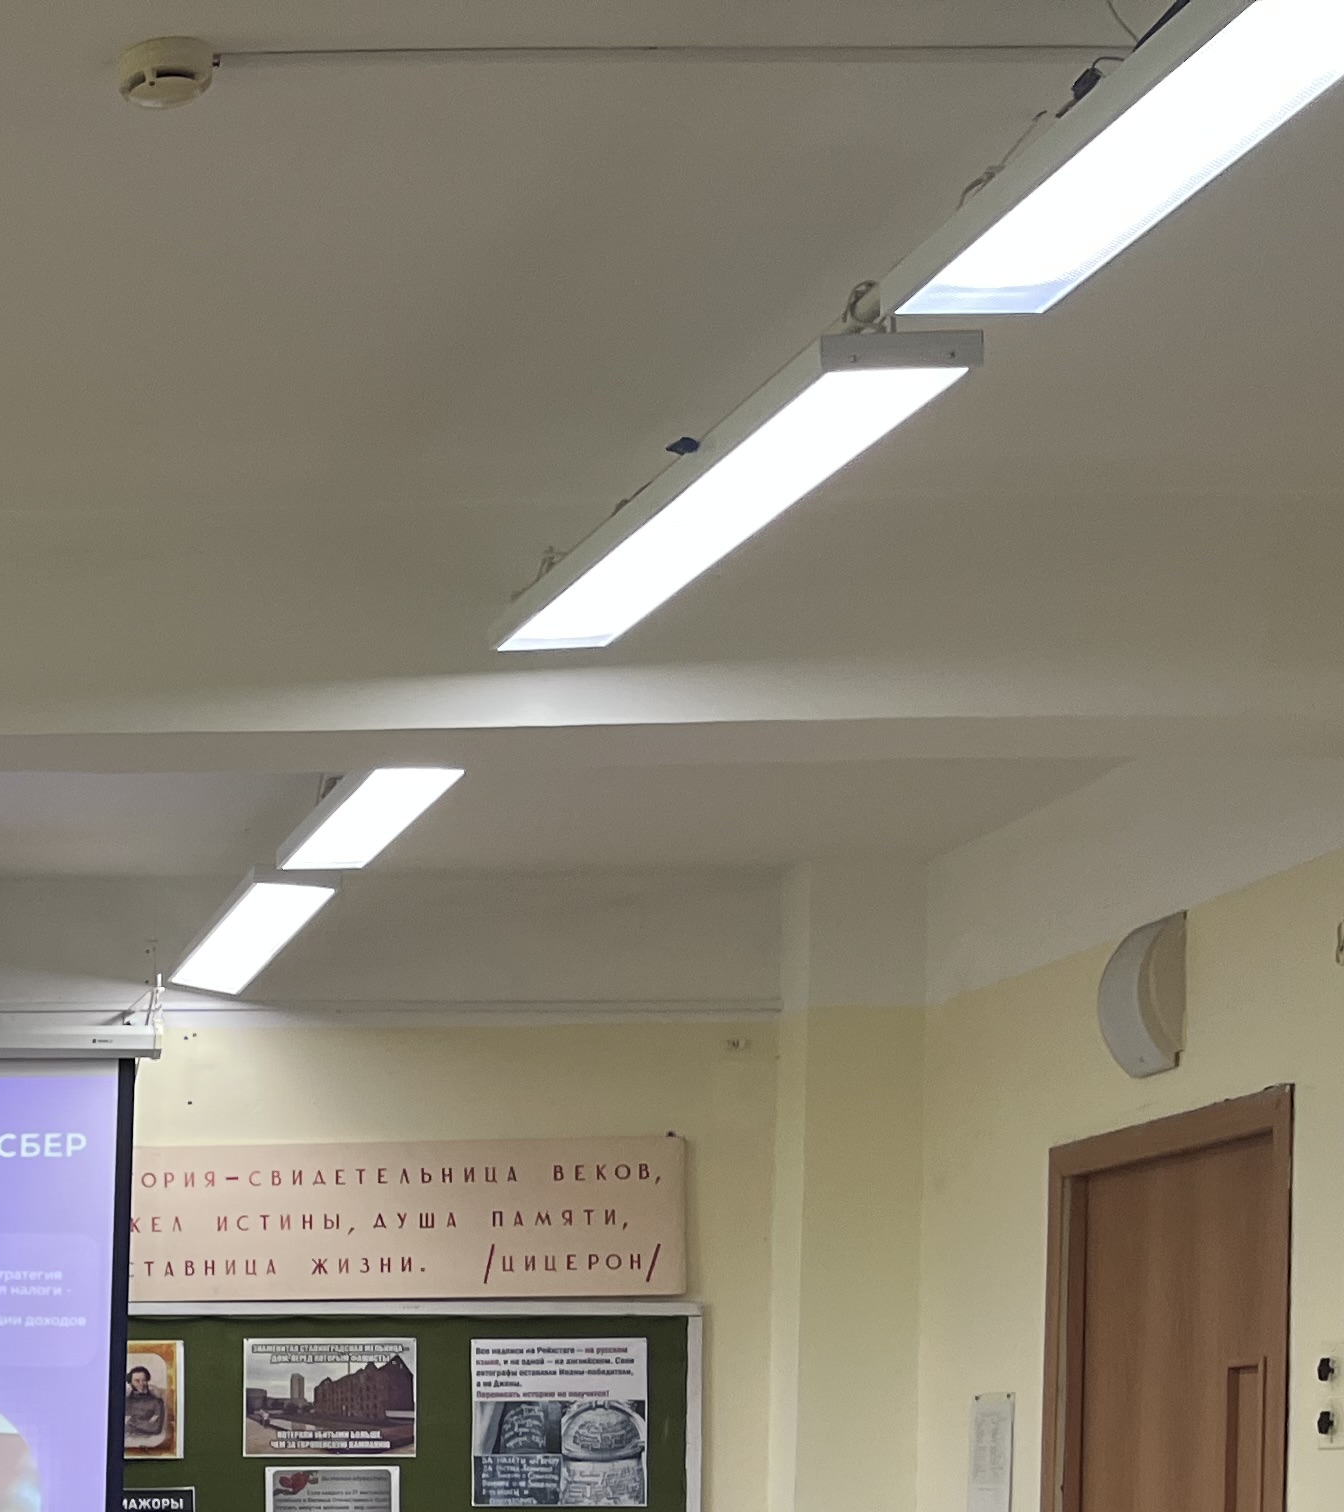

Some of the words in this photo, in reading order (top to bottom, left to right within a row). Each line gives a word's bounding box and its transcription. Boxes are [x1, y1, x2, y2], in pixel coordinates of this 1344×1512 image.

[553, 1163, 662, 1186] ВЕКОВ,
[130, 1216, 183, 1234] КЕЛ
[217, 1212, 356, 1236] ИСТИНЫ,
[373, 1211, 458, 1230] ДУША
[492, 1208, 629, 1231] ПАМЯТИ,
[129, 1259, 277, 1278] ТАВНИЦА
[311, 1255, 427, 1277] ЖИЗНИ.
[484, 1243, 661, 1285] /ЦИЦЕРОН/
[11, 1286, 62, 1297] налоги
[25, 1316, 87, 1328] доходов
